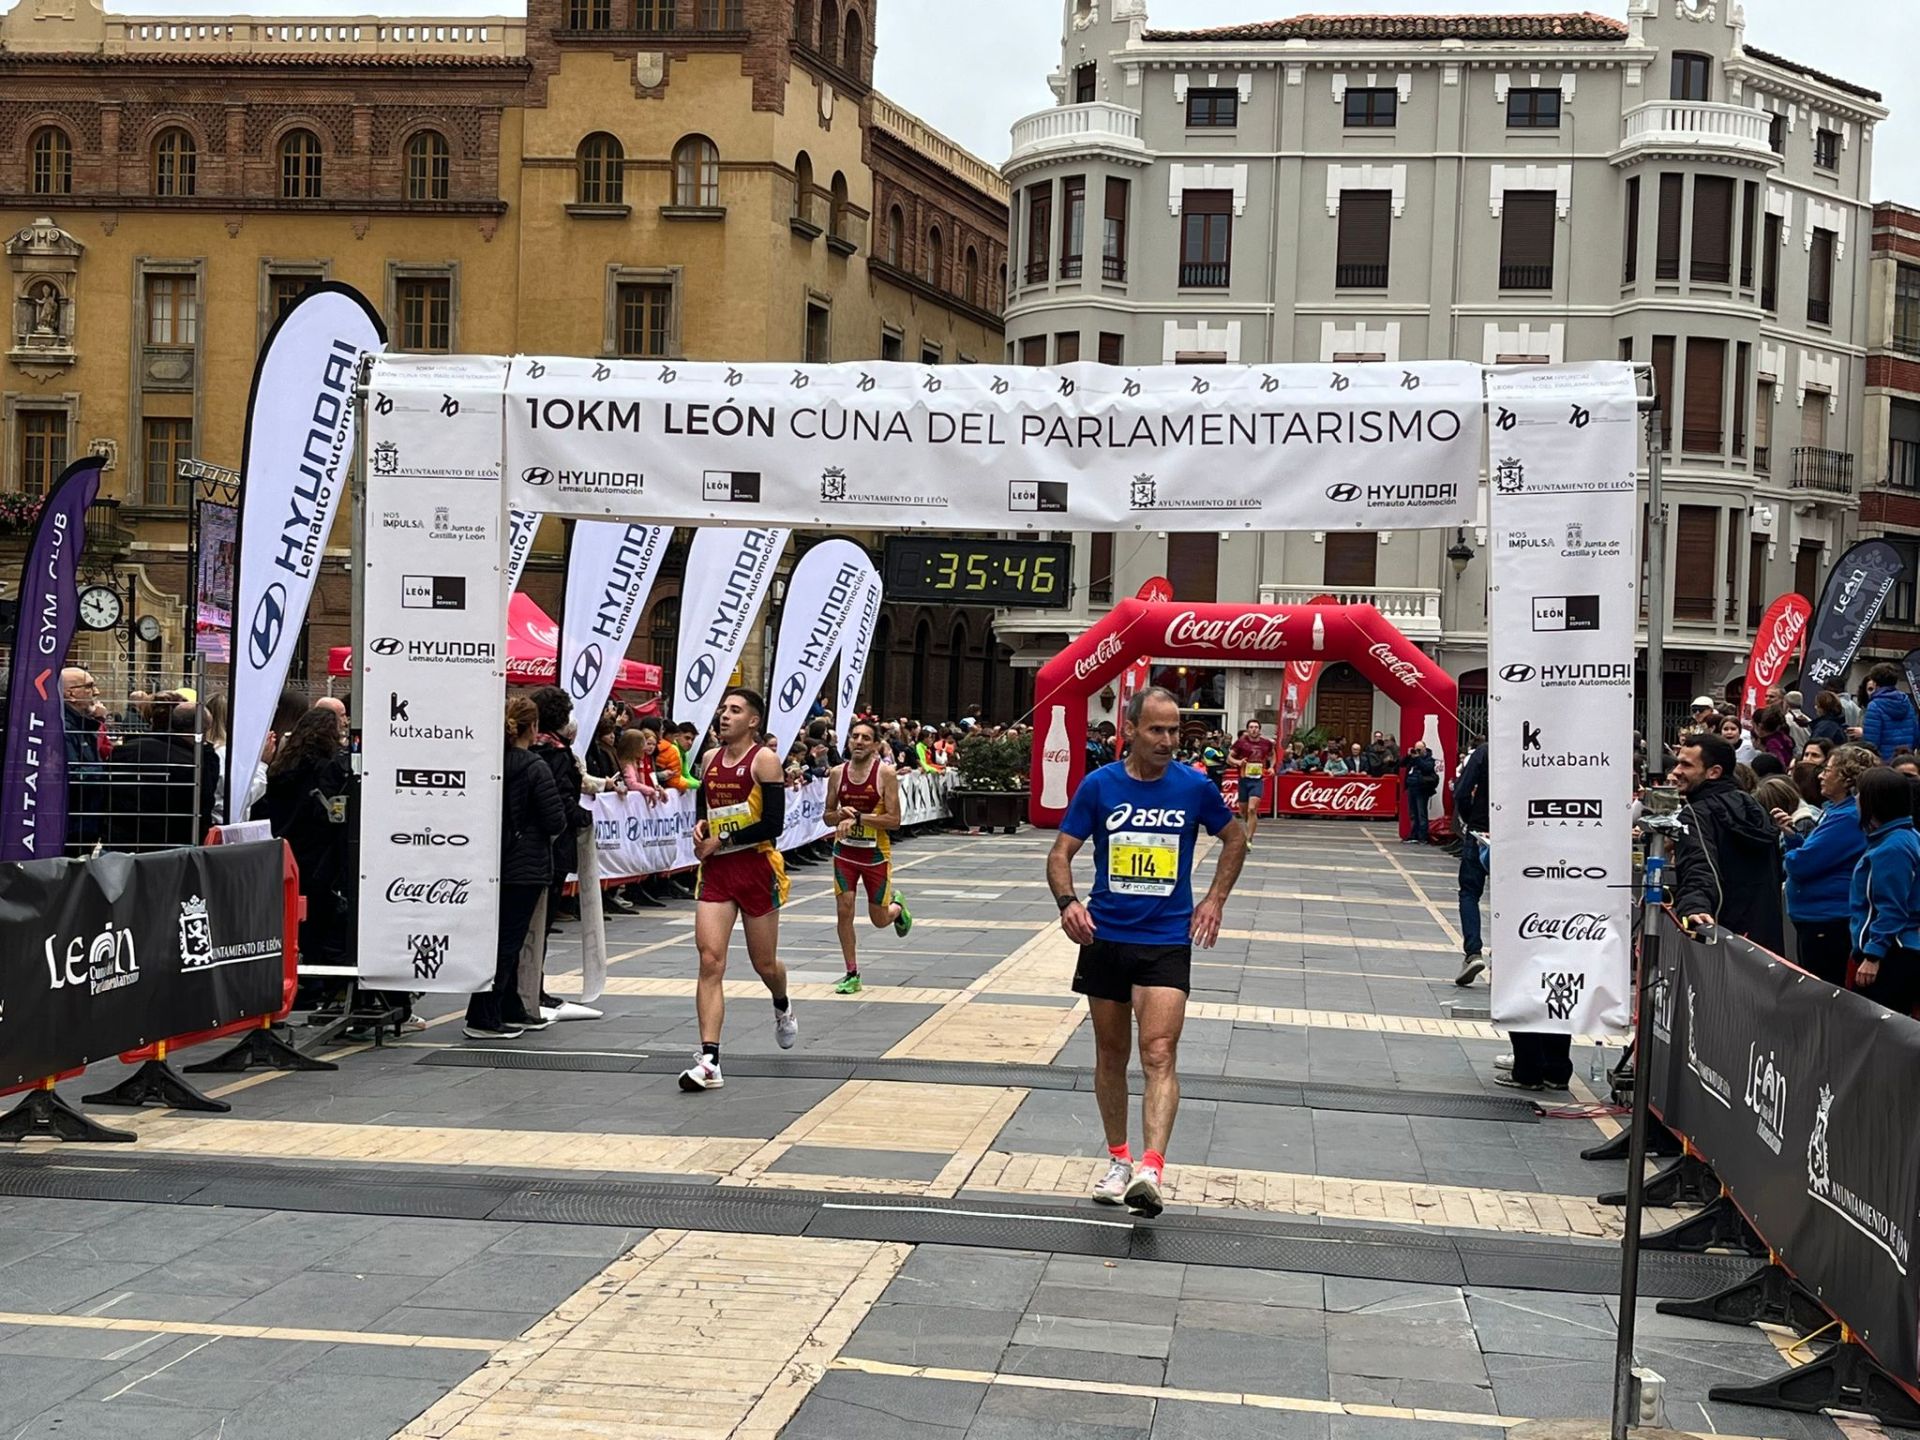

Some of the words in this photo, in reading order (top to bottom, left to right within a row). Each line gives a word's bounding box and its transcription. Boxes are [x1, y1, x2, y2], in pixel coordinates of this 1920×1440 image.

[526, 398, 640, 432] 10KM
[665, 398, 775, 437] LEÓN
[790, 408, 913, 442] CUNA
[929, 412, 1005, 444] DEL
[1021, 409, 1461, 448] PARLAMENTARISMO
[275, 339, 357, 573] HYUNDAI
[478, 468, 499, 476] LEÓN
[559, 471, 643, 487] HYUNDAI
[558, 485, 592, 493] Lemauto
[594, 485, 643, 495] Automoción
[707, 480, 729, 490] LEÓN
[1368, 483, 1457, 500] HYUNDAI
[1526, 483, 1595, 491] AYUNTAMIENTO
[848, 494, 912, 503] AYUNTAMIENTO
[914, 496, 924, 504] DE
[927, 494, 948, 504] LEÓN
[1012, 489, 1035, 500] LEÓN
[1158, 499, 1224, 507] AYUNTAMIENTO
[1226, 499, 1237, 507] DE
[1240, 498, 1262, 506] LEÓN
[1367, 499, 1405, 508] Lemauto
[1407, 498, 1456, 507] Automoción
[295, 486, 331, 579] Lemauto
[429, 532, 456, 540] Castilla
[465, 532, 485, 540] León
[451, 524, 472, 532] Junta
[48, 512, 68, 580] CLUB
[1584, 540, 1607, 548] Junta
[406, 586, 430, 595] LEÓN
[612, 583, 640, 642] Lemauto
[634, 524, 661, 581] Automo
[705, 528, 768, 649] HYUNDA
[724, 602, 750, 652] Lemauto
[746, 529, 779, 601] Automoción
[799, 562, 859, 668] HYUNDAI
[1537, 607, 1564, 618] LEÓN
[39, 593, 58, 655] GYM
[814, 630, 838, 672] Lemauto
[836, 570, 867, 629] Automoción
[850, 584, 877, 671] HYUNDAI
[1165, 611, 1292, 651] Coca-Cola
[409, 641, 495, 657] HYUNDAI
[1755, 602, 1805, 686] Coca-Cola
[445, 656, 495, 664] Automoción
[1075, 631, 1122, 680] Coca-Cola
[1368, 643, 1426, 686] Coca-Cola
[1541, 664, 1630, 679] HYUNDAI
[1578, 678, 1631, 686] Automoción
[390, 724, 474, 739] kutxabank
[1522, 752, 1610, 767] kutxabank
[22, 712, 45, 853] ALTAFIT
[399, 772, 463, 785] LEON
[396, 789, 466, 797] PLAZA
[1290, 780, 1381, 811] Coca-Cola
[1531, 803, 1600, 815] LEON
[1131, 809, 1186, 827] asics
[391, 827, 469, 846] emico
[1131, 854, 1155, 876] 114
[1523, 859, 1607, 879] emico
[385, 877, 472, 904] Coca-Cola
[1519, 912, 1611, 941] Coca-Cola
[257, 941, 265, 952] DE
[266, 936, 282, 951] LEÓN
[408, 935, 449, 950] KAM
[412, 950, 443, 964] ARI
[414, 964, 442, 979] NY
[1541, 973, 1585, 989] KAM
[1546, 989, 1578, 1004] ARI
[1548, 1003, 1575, 1020] NY
[1832, 1181, 1888, 1237] AYUNTAMIENTO
